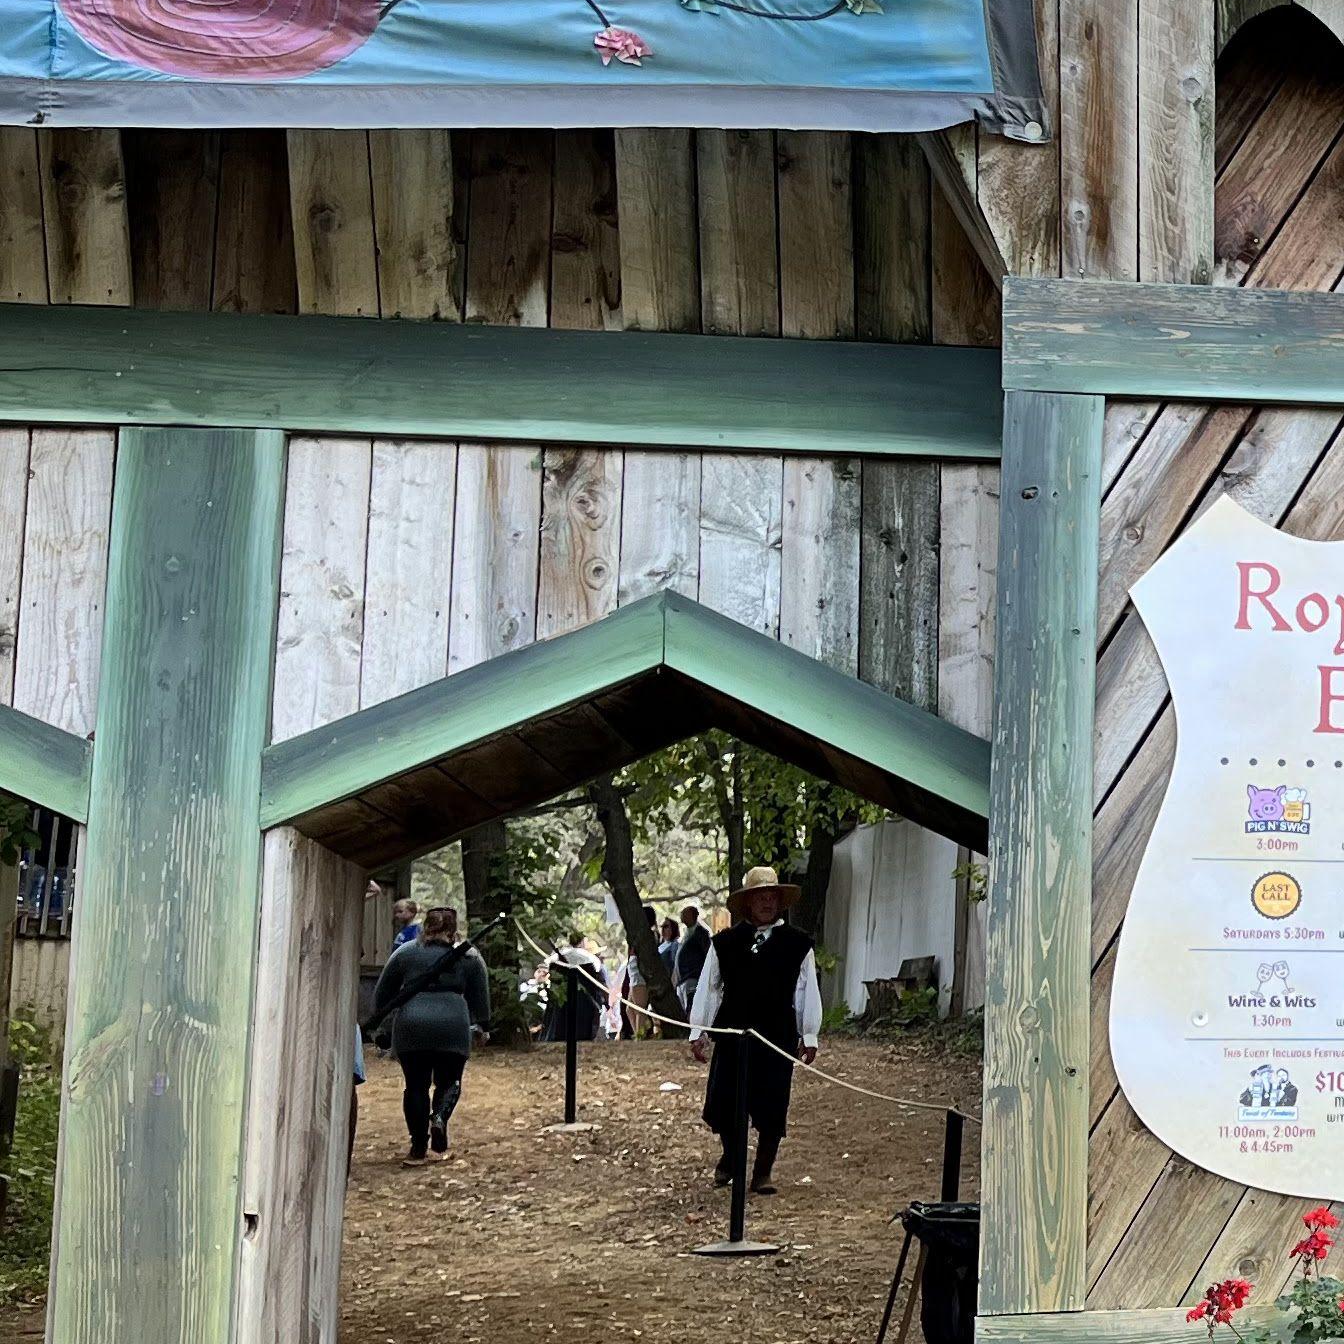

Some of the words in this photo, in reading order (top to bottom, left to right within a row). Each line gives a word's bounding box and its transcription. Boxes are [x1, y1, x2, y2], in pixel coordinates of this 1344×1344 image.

[1248, 823, 1264, 831] PIG
[1281, 823, 1307, 833] SWIG
[1262, 884, 1290, 892] LAST
[1261, 893, 1291, 901] CALL
[1228, 995, 1265, 1007] Wine
[1269, 996, 1280, 1007] &
[1284, 996, 1316, 1007] Wits
[1240, 1142, 1247, 1152] &
